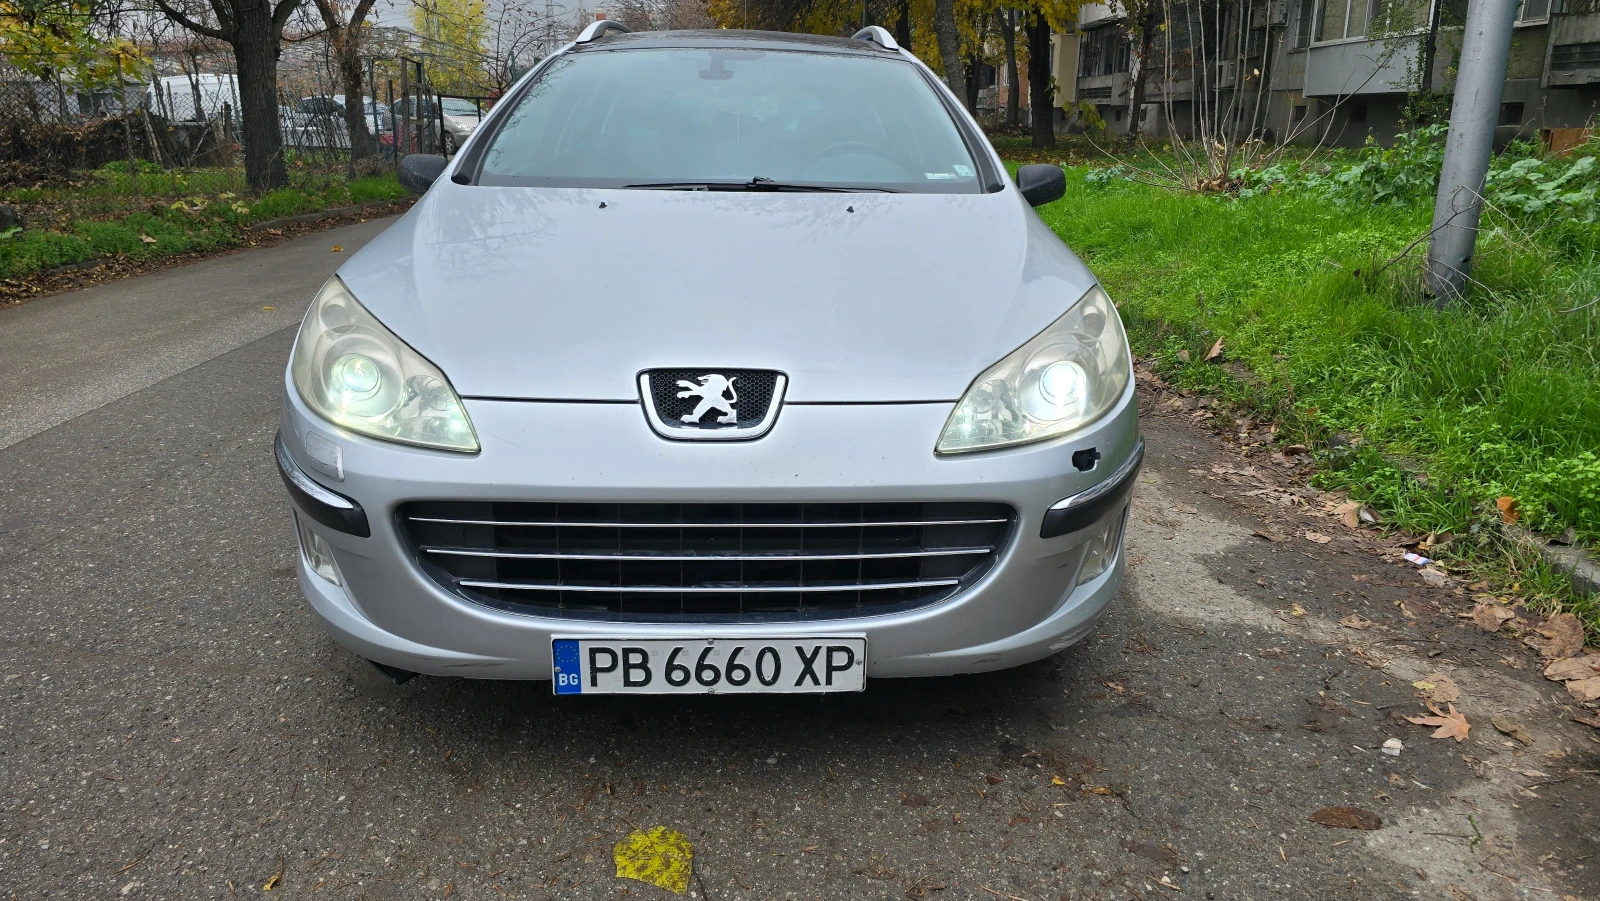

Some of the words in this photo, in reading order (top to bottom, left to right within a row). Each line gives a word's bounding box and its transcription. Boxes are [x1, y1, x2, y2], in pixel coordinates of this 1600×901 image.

[558, 673, 579, 686] BG
[588, 647, 652, 687] PB
[664, 646, 781, 687] 6660
[794, 645, 855, 687] XP
